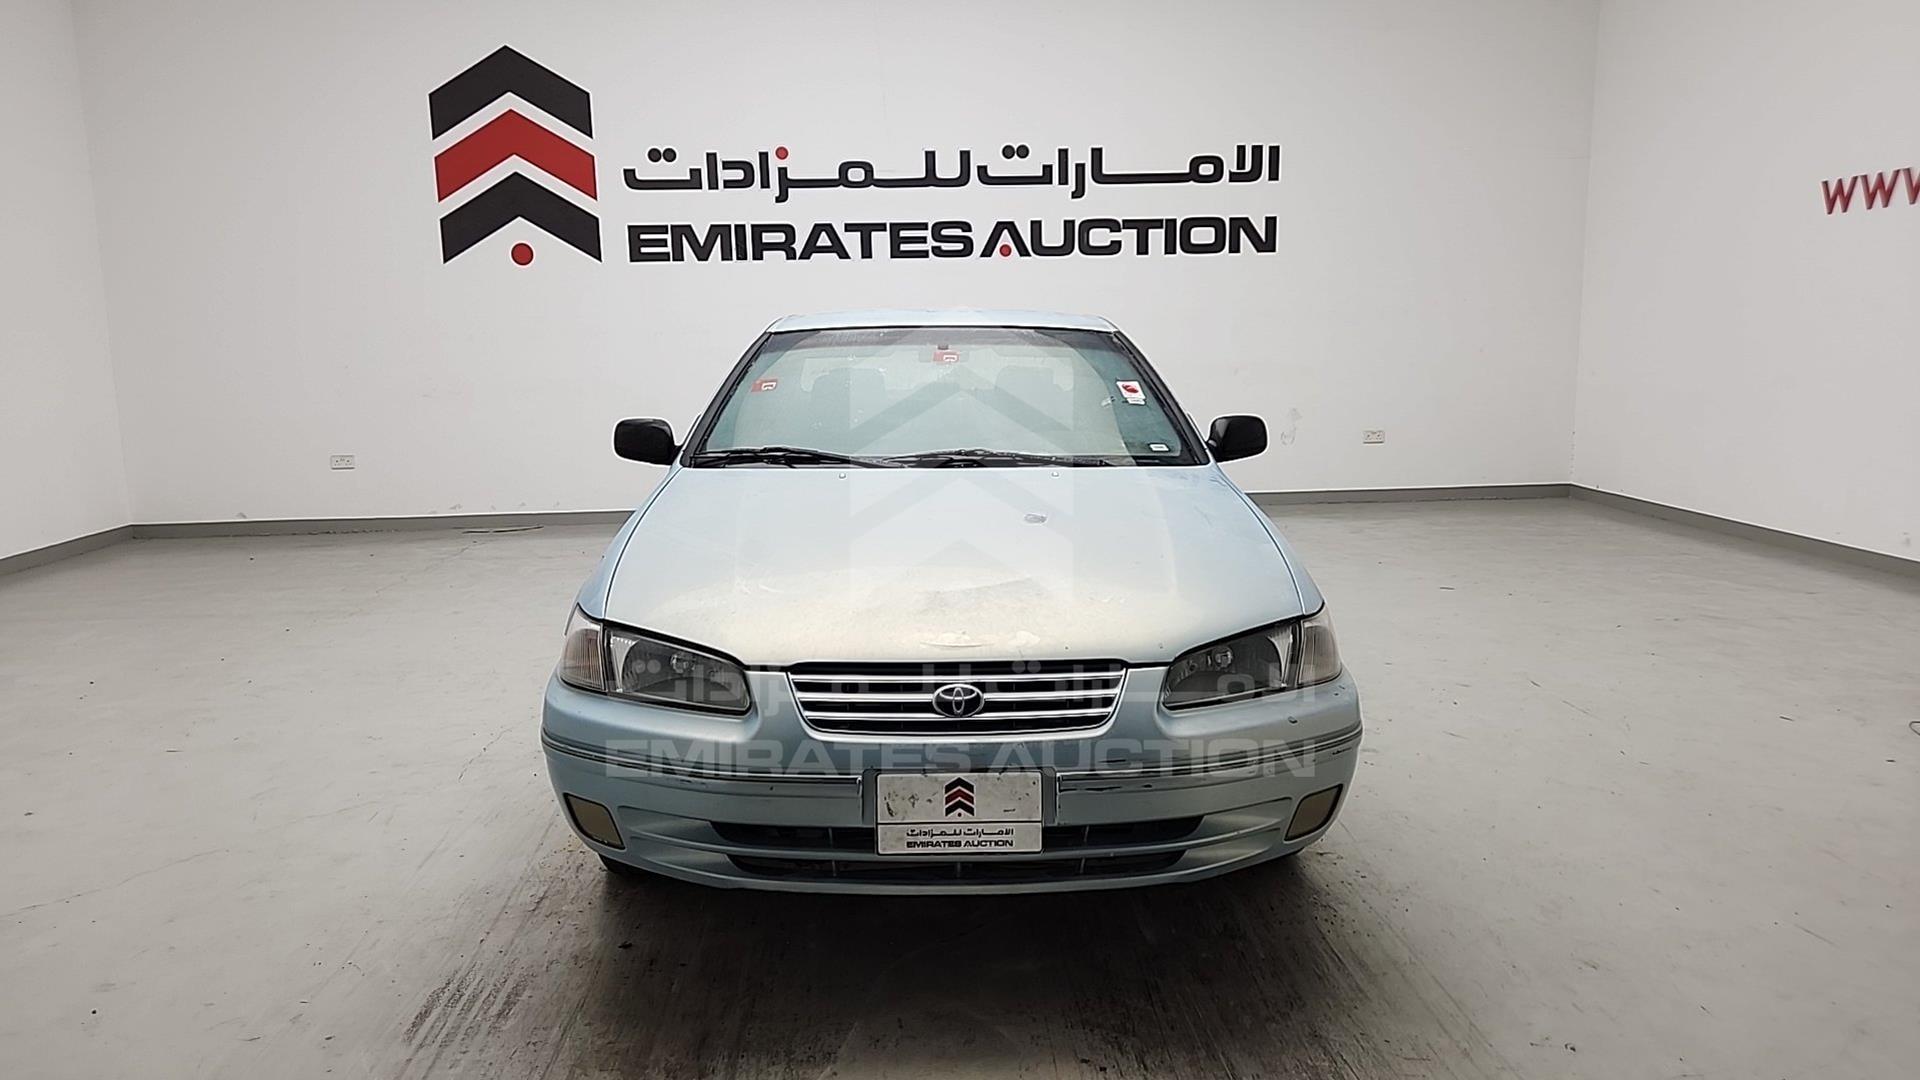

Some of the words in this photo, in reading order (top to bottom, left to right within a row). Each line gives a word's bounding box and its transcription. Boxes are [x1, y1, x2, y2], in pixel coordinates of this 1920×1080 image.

[623, 146, 971, 203] للمزادات
[976, 144, 1280, 200] الامارات
[627, 221, 974, 263] EMIRATES
[979, 216, 1277, 258] AUCTION
[906, 840, 962, 848] EMIRATES
[963, 839, 1014, 848] AUCTION
